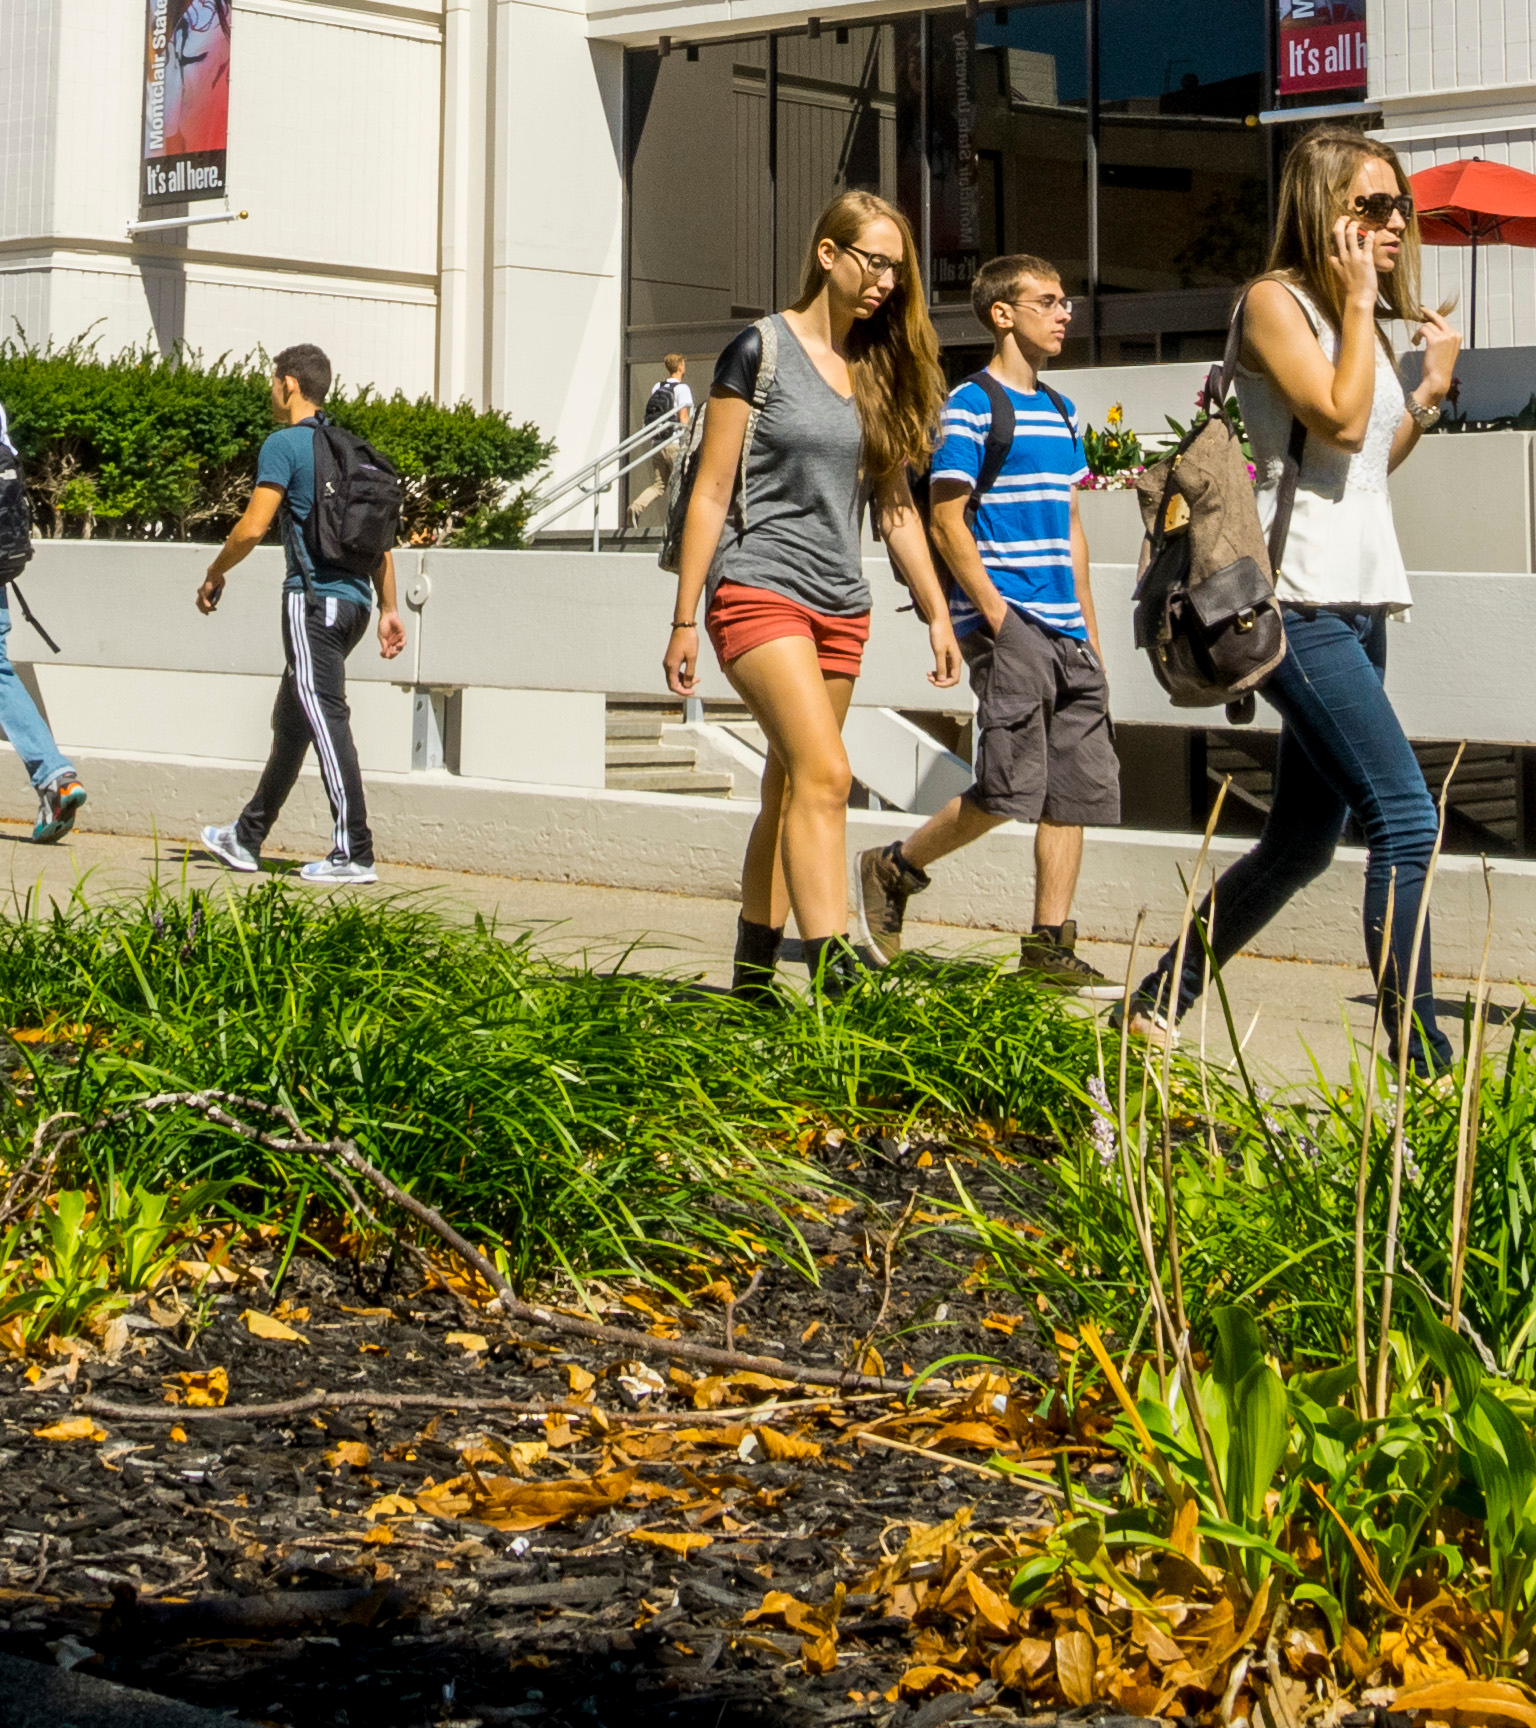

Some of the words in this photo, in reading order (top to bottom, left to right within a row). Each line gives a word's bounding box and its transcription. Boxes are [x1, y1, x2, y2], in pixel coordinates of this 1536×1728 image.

[1289, 38, 1320, 78] It's
[1324, 33, 1351, 73] all
[149, 55, 166, 150] Montclair
[147, 164, 167, 195] It's
[168, 161, 185, 193] all
[186, 160, 223, 191] here.
